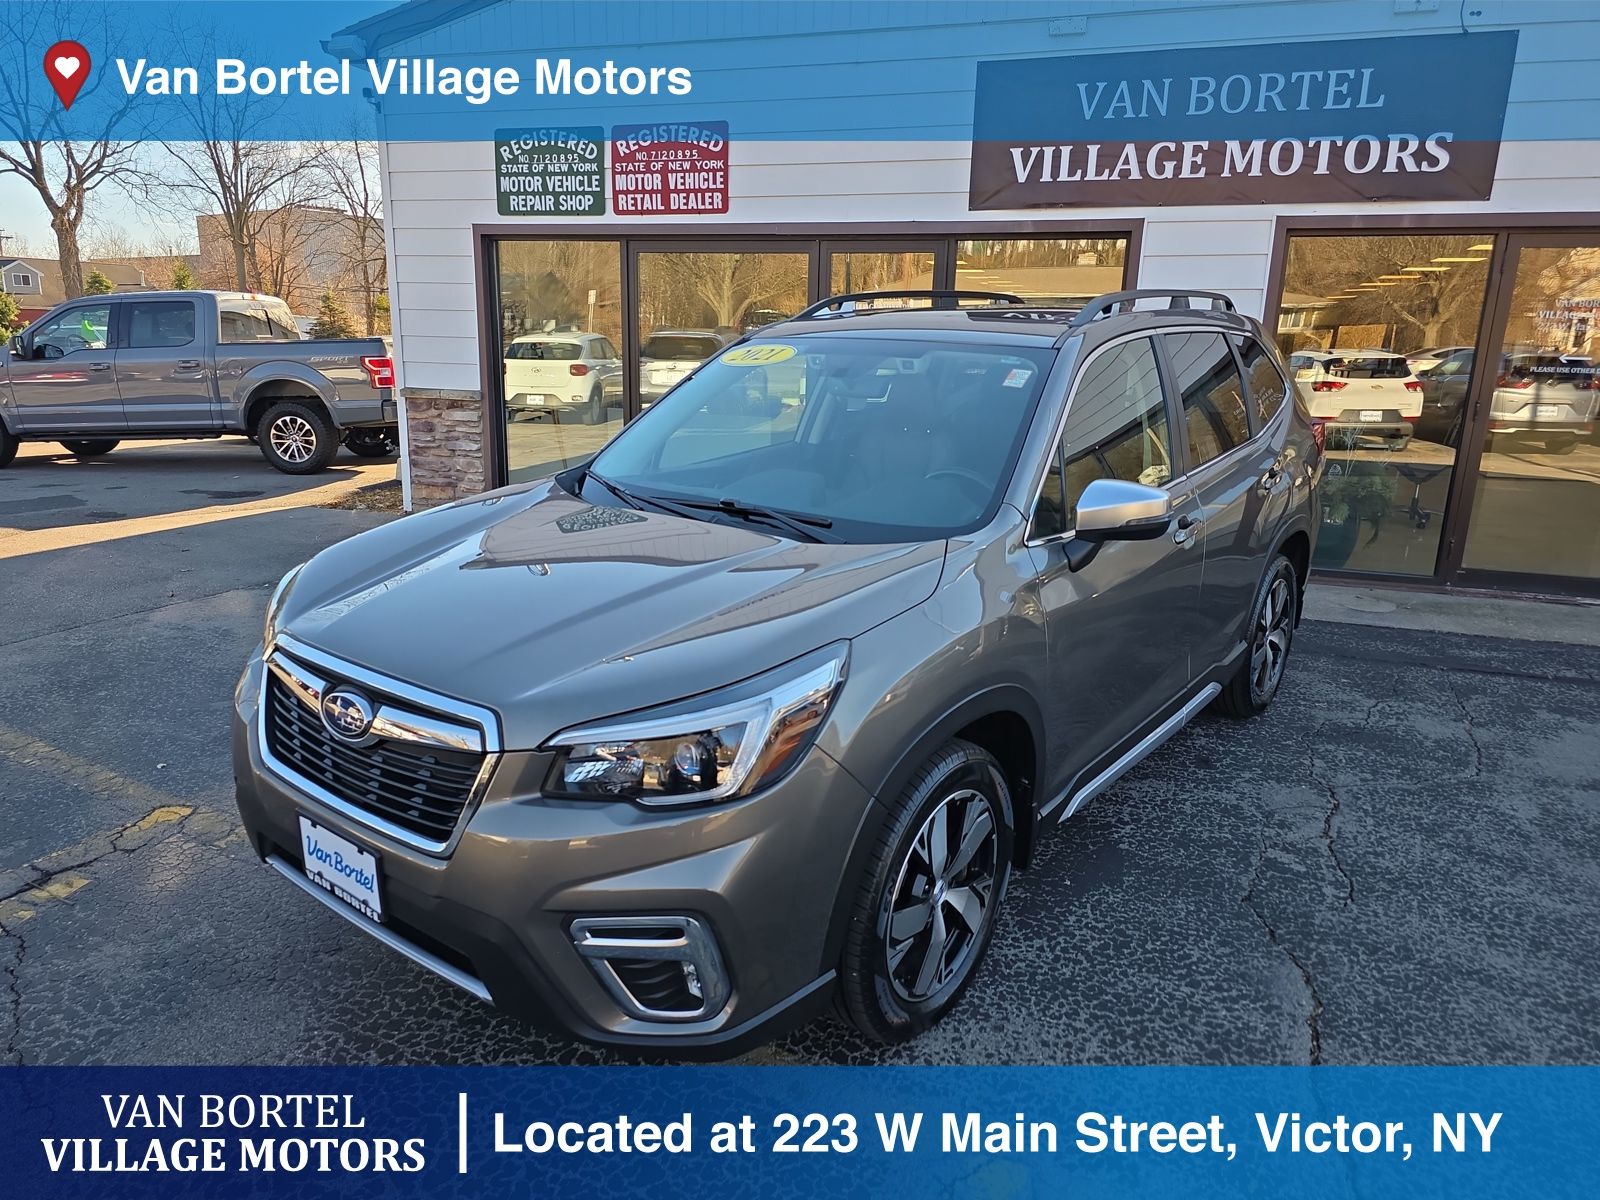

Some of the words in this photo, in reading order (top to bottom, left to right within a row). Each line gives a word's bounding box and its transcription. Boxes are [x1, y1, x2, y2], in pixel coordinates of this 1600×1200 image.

[1076, 78, 1173, 120] VAN
[1186, 67, 1385, 116] BORTEL
[500, 129, 598, 162] REGISTERED
[615, 125, 724, 157] REGISTERED
[533, 153, 579, 163] 7120895
[650, 150, 698, 159] 7120895
[1009, 140, 1209, 184] VILLAGE
[1220, 131, 1454, 178] MOTORS
[500, 165, 529, 173] STATE
[532, 164, 544, 173] OF
[547, 163, 570, 172] NEW
[572, 163, 598, 172] YORK
[615, 162, 646, 172] STATE
[650, 162, 664, 171] OF
[668, 161, 693, 170] NEW
[696, 160, 725, 169] YORK
[500, 176, 543, 193] MOTOR
[546, 175, 600, 192] VEHICLE
[615, 174, 662, 191] MOTOR
[668, 172, 725, 190] VEHICLE
[510, 195, 555, 211] REPAIR
[559, 195, 594, 211] SHOP
[618, 193, 665, 211] RETAIL
[670, 192, 722, 210] DEALER
[1539, 310, 1583, 319] VILLAG
